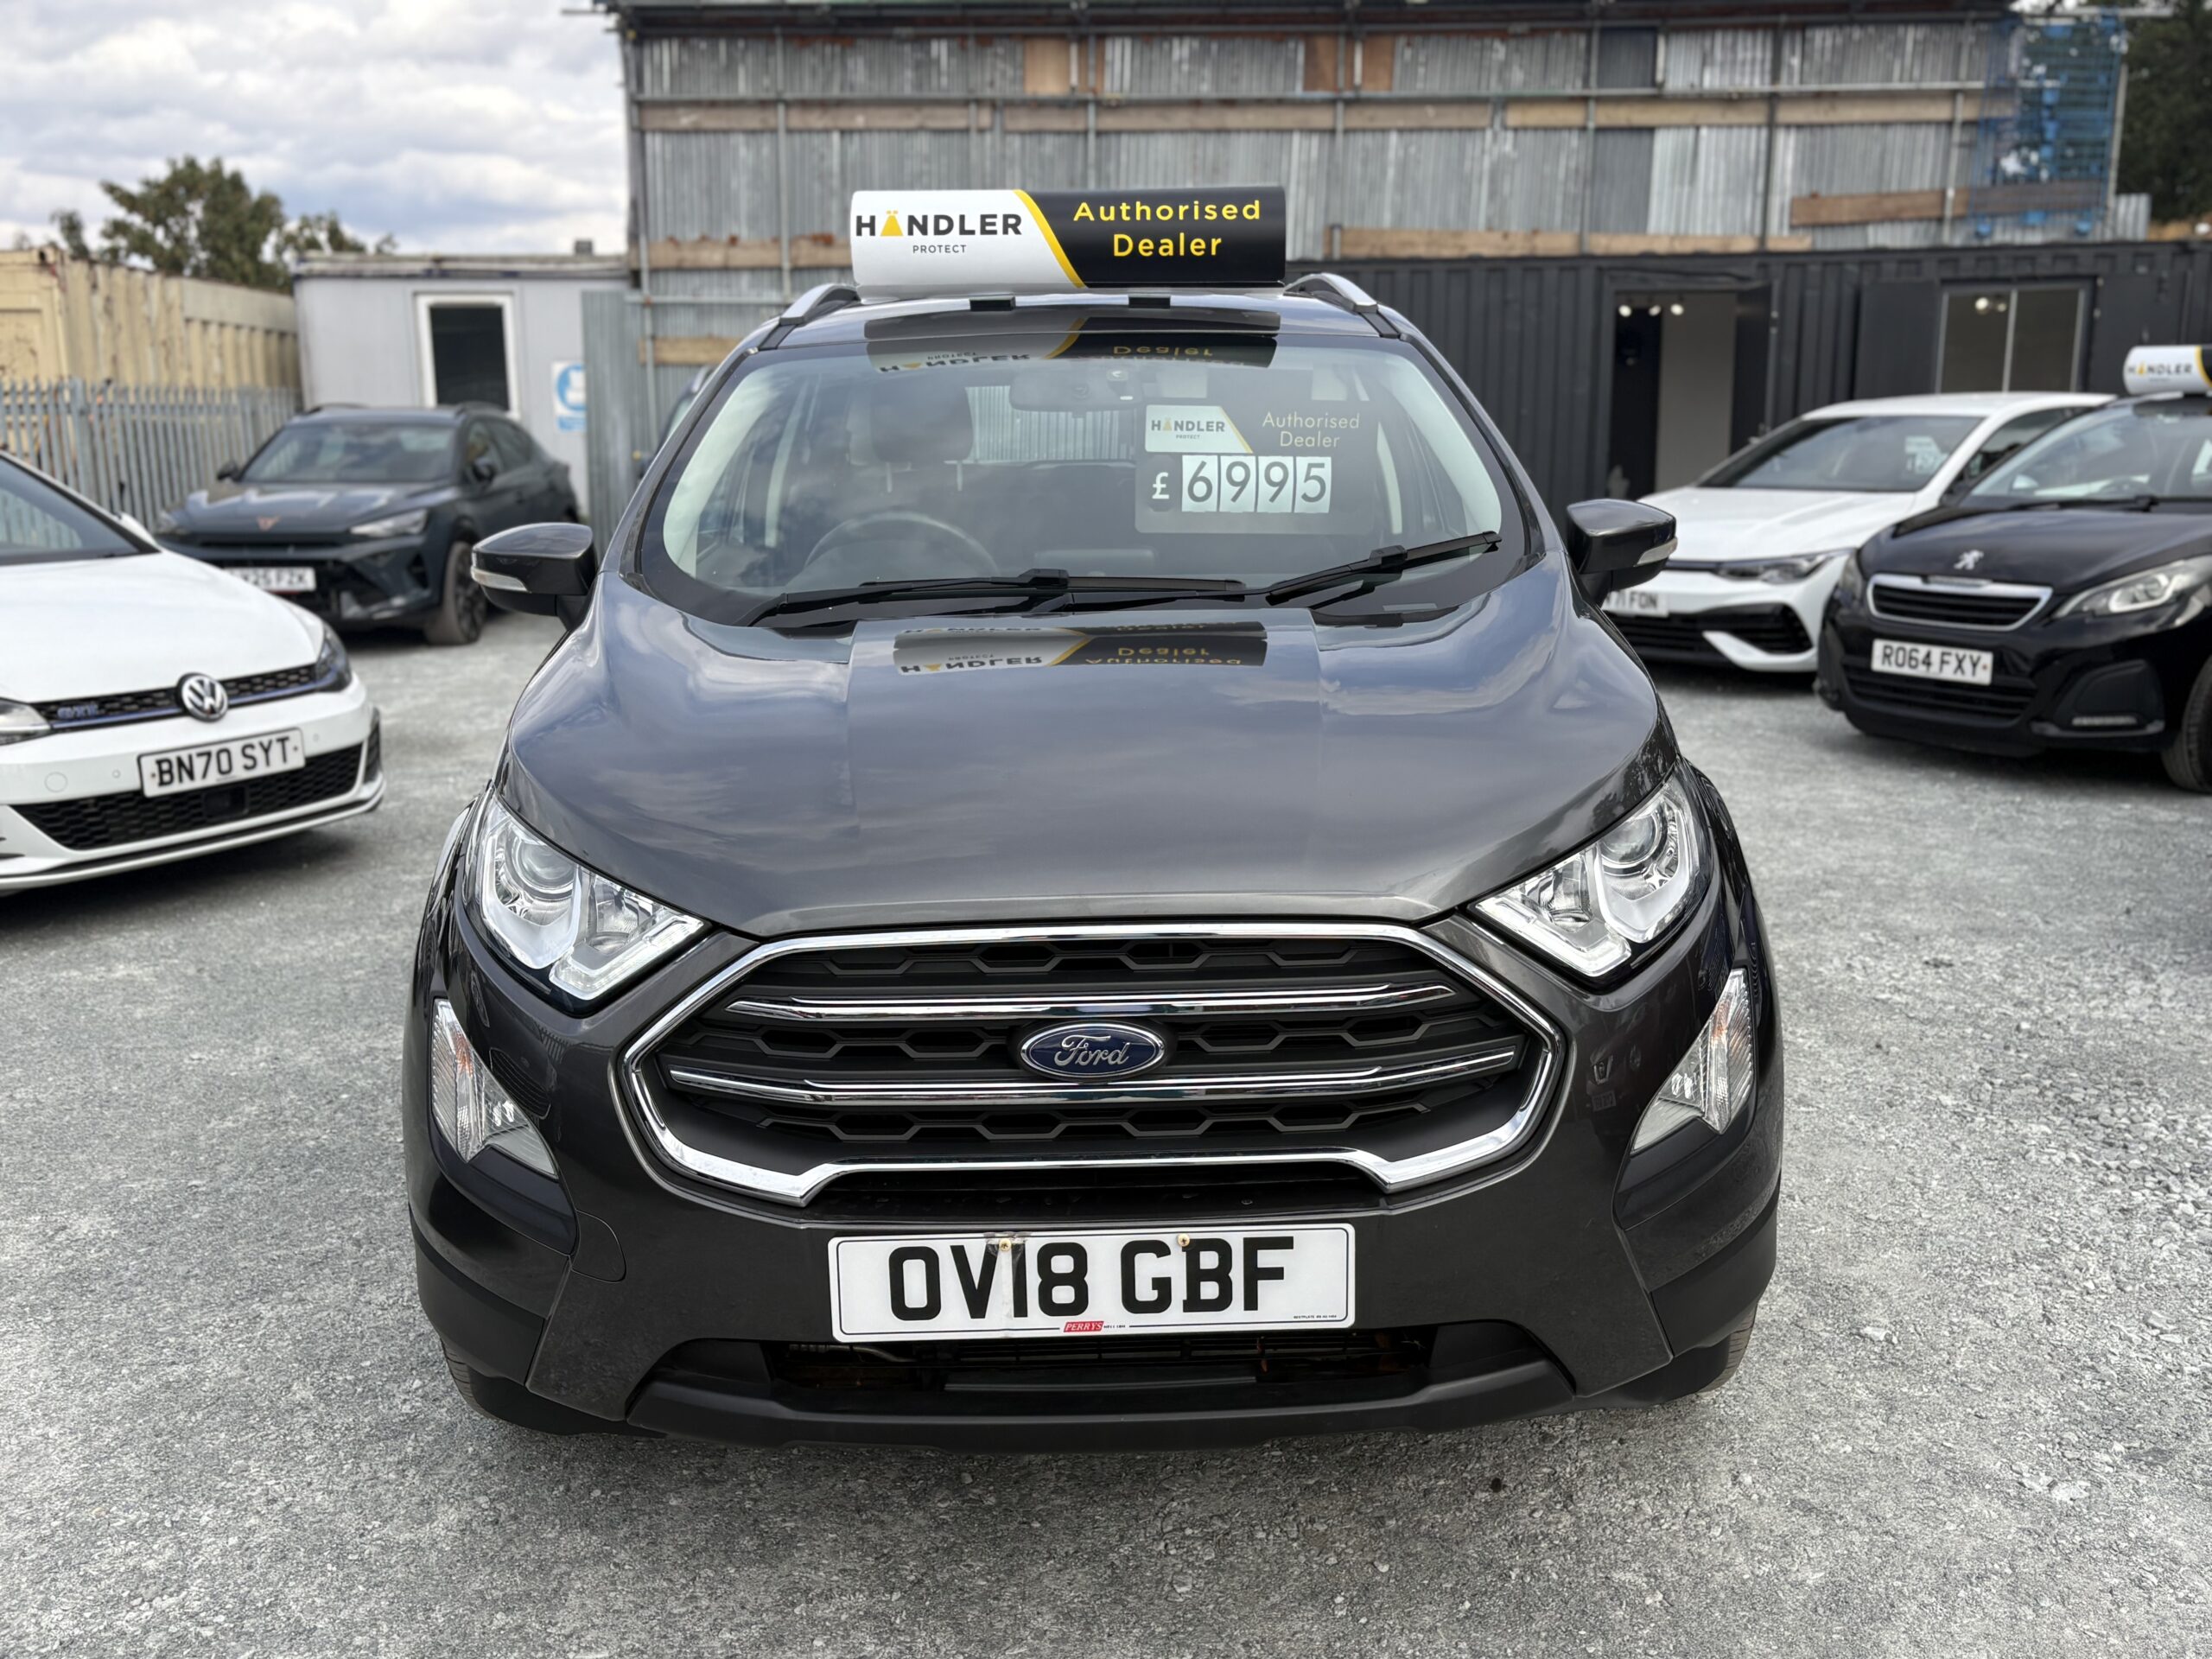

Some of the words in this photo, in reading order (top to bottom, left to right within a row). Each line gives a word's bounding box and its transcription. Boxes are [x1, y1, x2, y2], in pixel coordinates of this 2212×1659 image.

[855, 210, 1022, 237] HÄNDLER
[1073, 200, 1261, 222] Authorised
[912, 245, 967, 254] PROTECT
[1114, 232, 1222, 257] Dealer
[1262, 411, 1360, 429] Authorised
[1281, 431, 1340, 448] Dealer
[1187, 460, 1326, 503] 6995
[1882, 645, 1932, 672] RO64
[1940, 652, 1981, 677] FXY
[156, 748, 232, 787] BN70
[242, 736, 289, 771] SYT
[1053, 1034, 1130, 1066] Ford
[888, 1241, 1089, 1321] OV18
[1120, 1236, 1294, 1314] GBF
[1065, 1322, 1103, 1332] PERRYS
